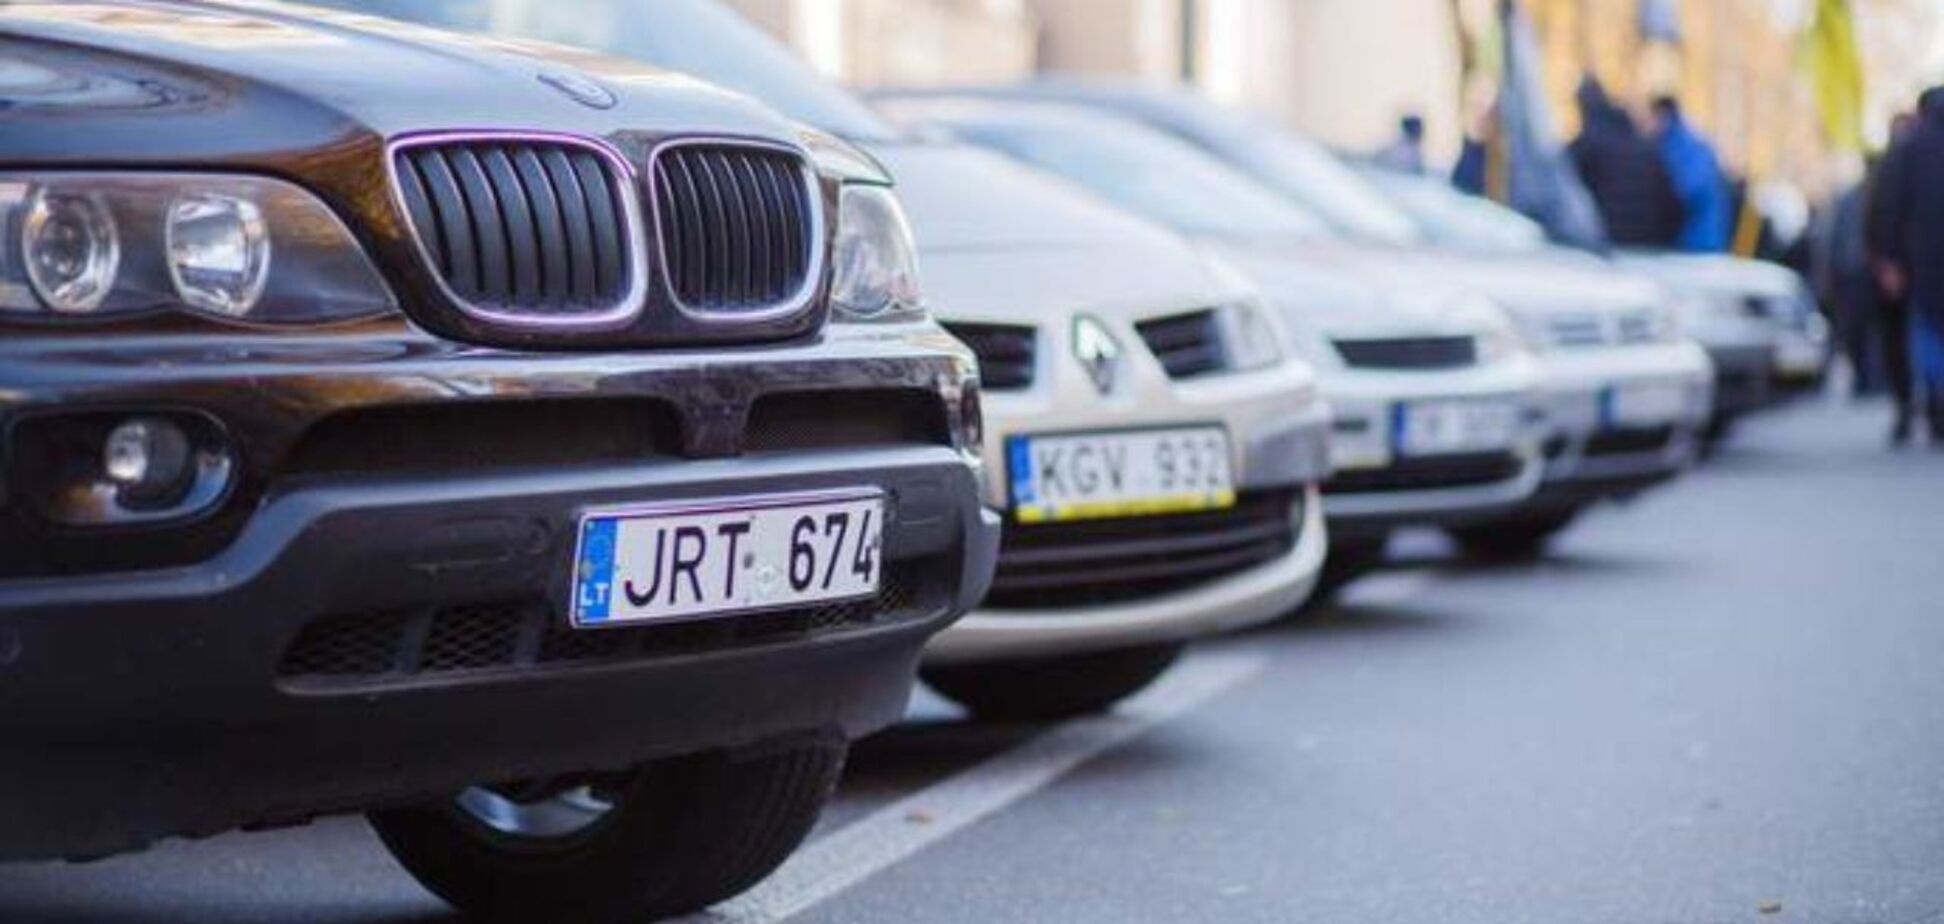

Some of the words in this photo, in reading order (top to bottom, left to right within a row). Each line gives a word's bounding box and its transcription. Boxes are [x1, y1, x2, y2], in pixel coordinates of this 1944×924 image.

[1038, 445, 1125, 495] KGV
[1154, 438, 1219, 487] 932
[624, 521, 750, 607] JRT
[788, 509, 880, 592] 674
[579, 583, 609, 607] LT
